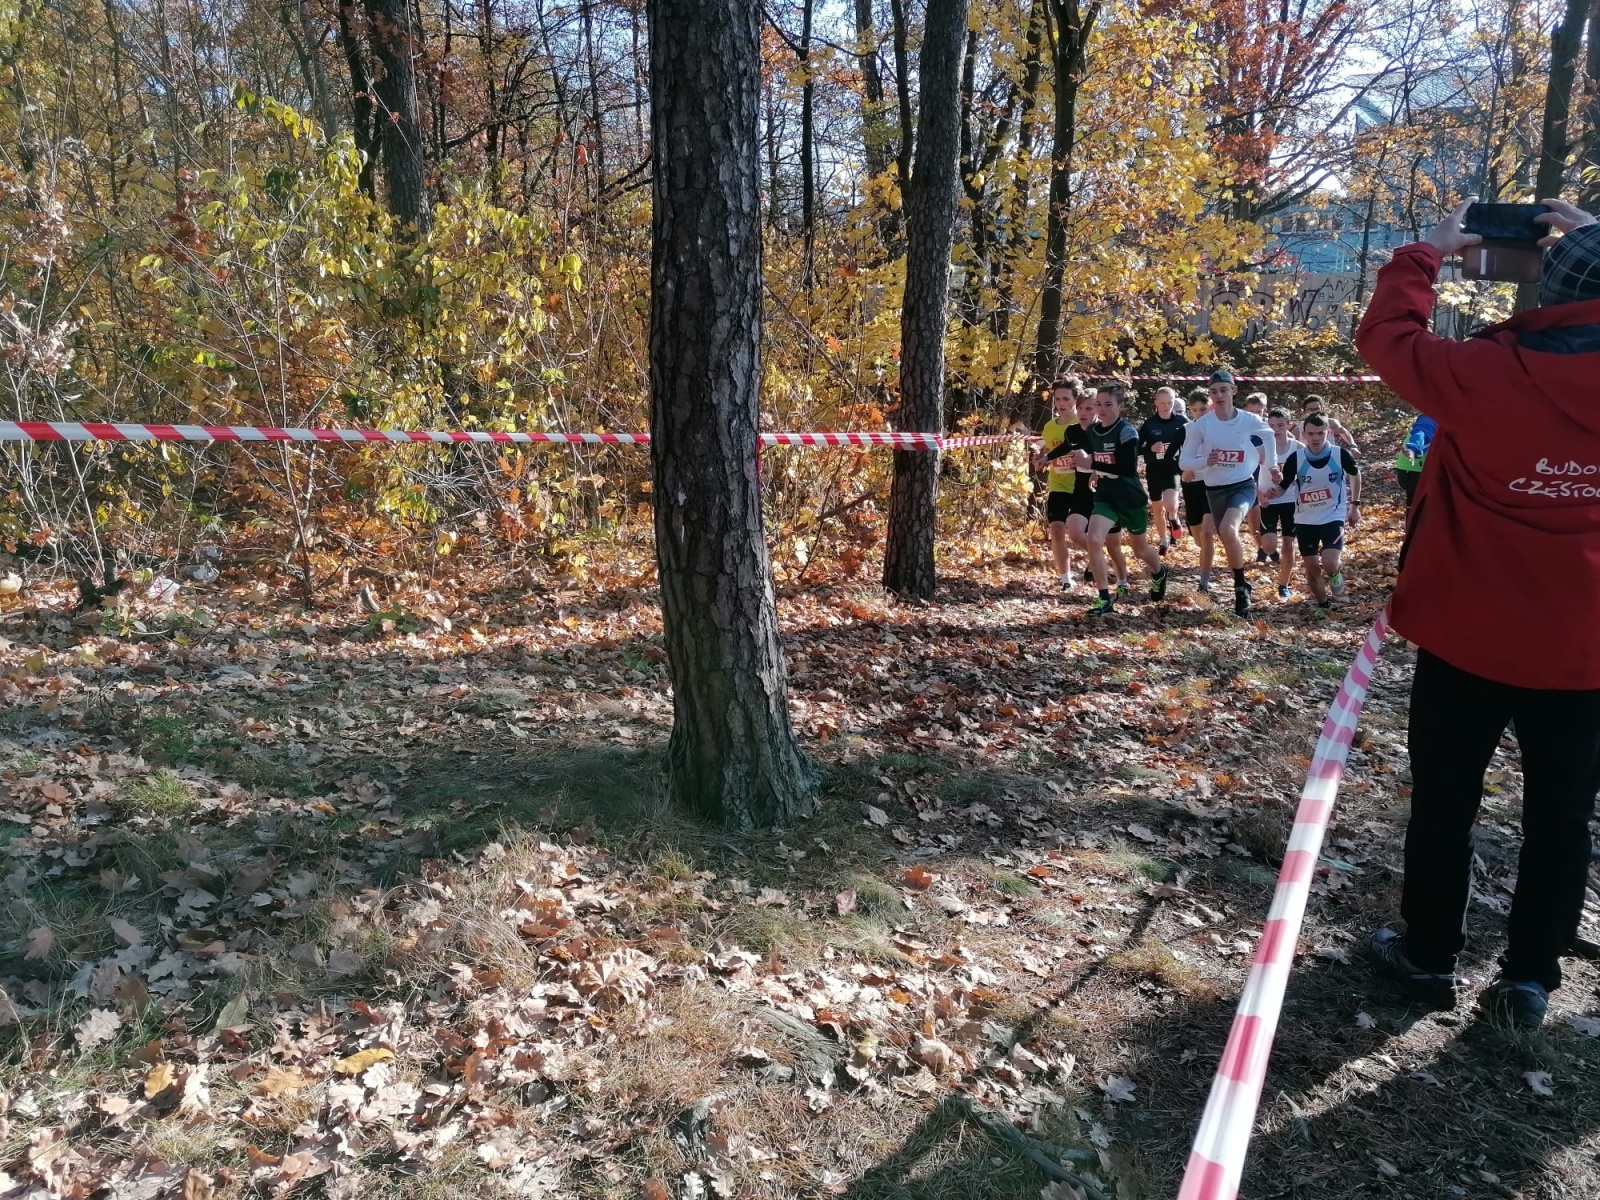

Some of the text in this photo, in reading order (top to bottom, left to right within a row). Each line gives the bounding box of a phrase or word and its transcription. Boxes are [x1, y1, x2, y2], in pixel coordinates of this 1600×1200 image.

[1217, 450, 1239, 462] 412
[1535, 457, 1600, 476] BUDO
[1301, 475, 1312, 484] 22
[1303, 490, 1328, 502] 408
